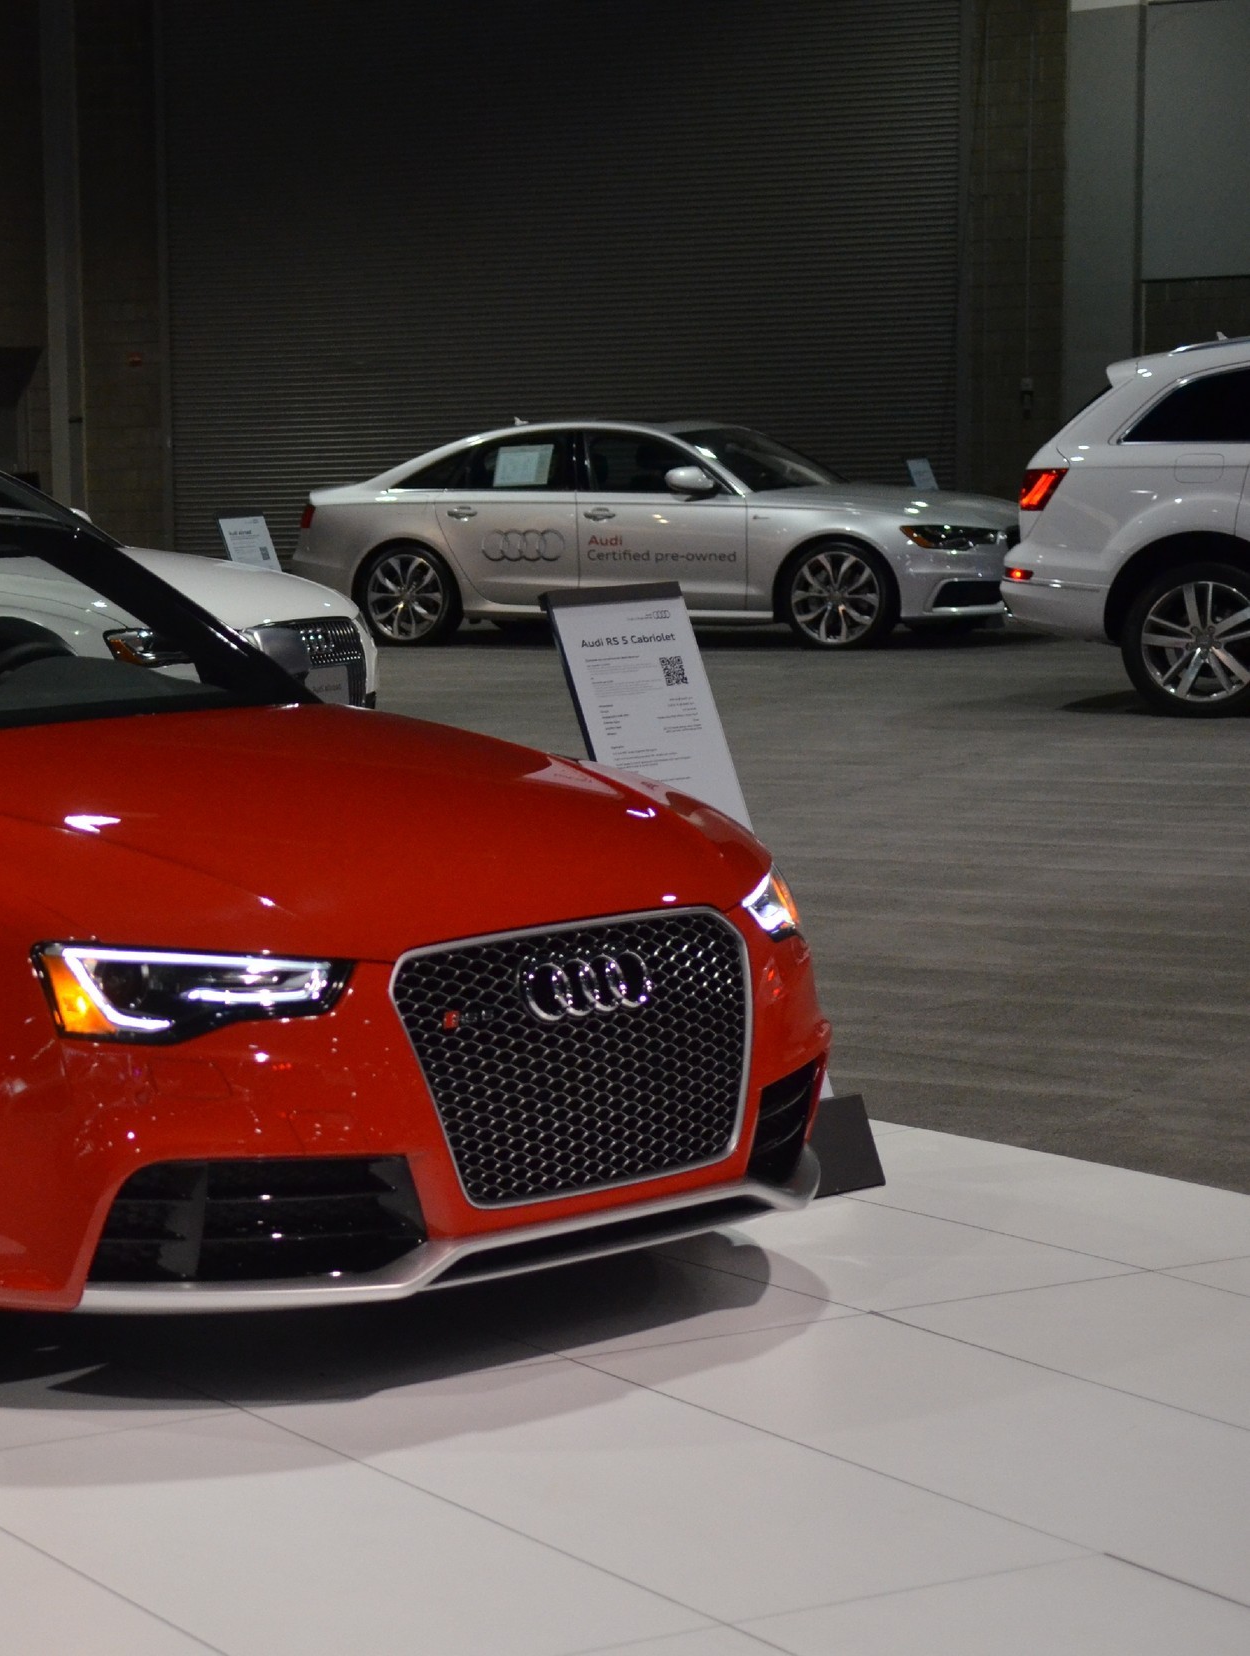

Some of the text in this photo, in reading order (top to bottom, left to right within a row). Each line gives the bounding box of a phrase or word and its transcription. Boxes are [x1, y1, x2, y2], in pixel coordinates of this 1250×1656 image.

[588, 535, 623, 546] Audi
[587, 549, 737, 564] Certified pre-owned
[581, 638, 604, 649] Audi
[606, 636, 619, 646] RS
[630, 632, 676, 645] Cabriolet
